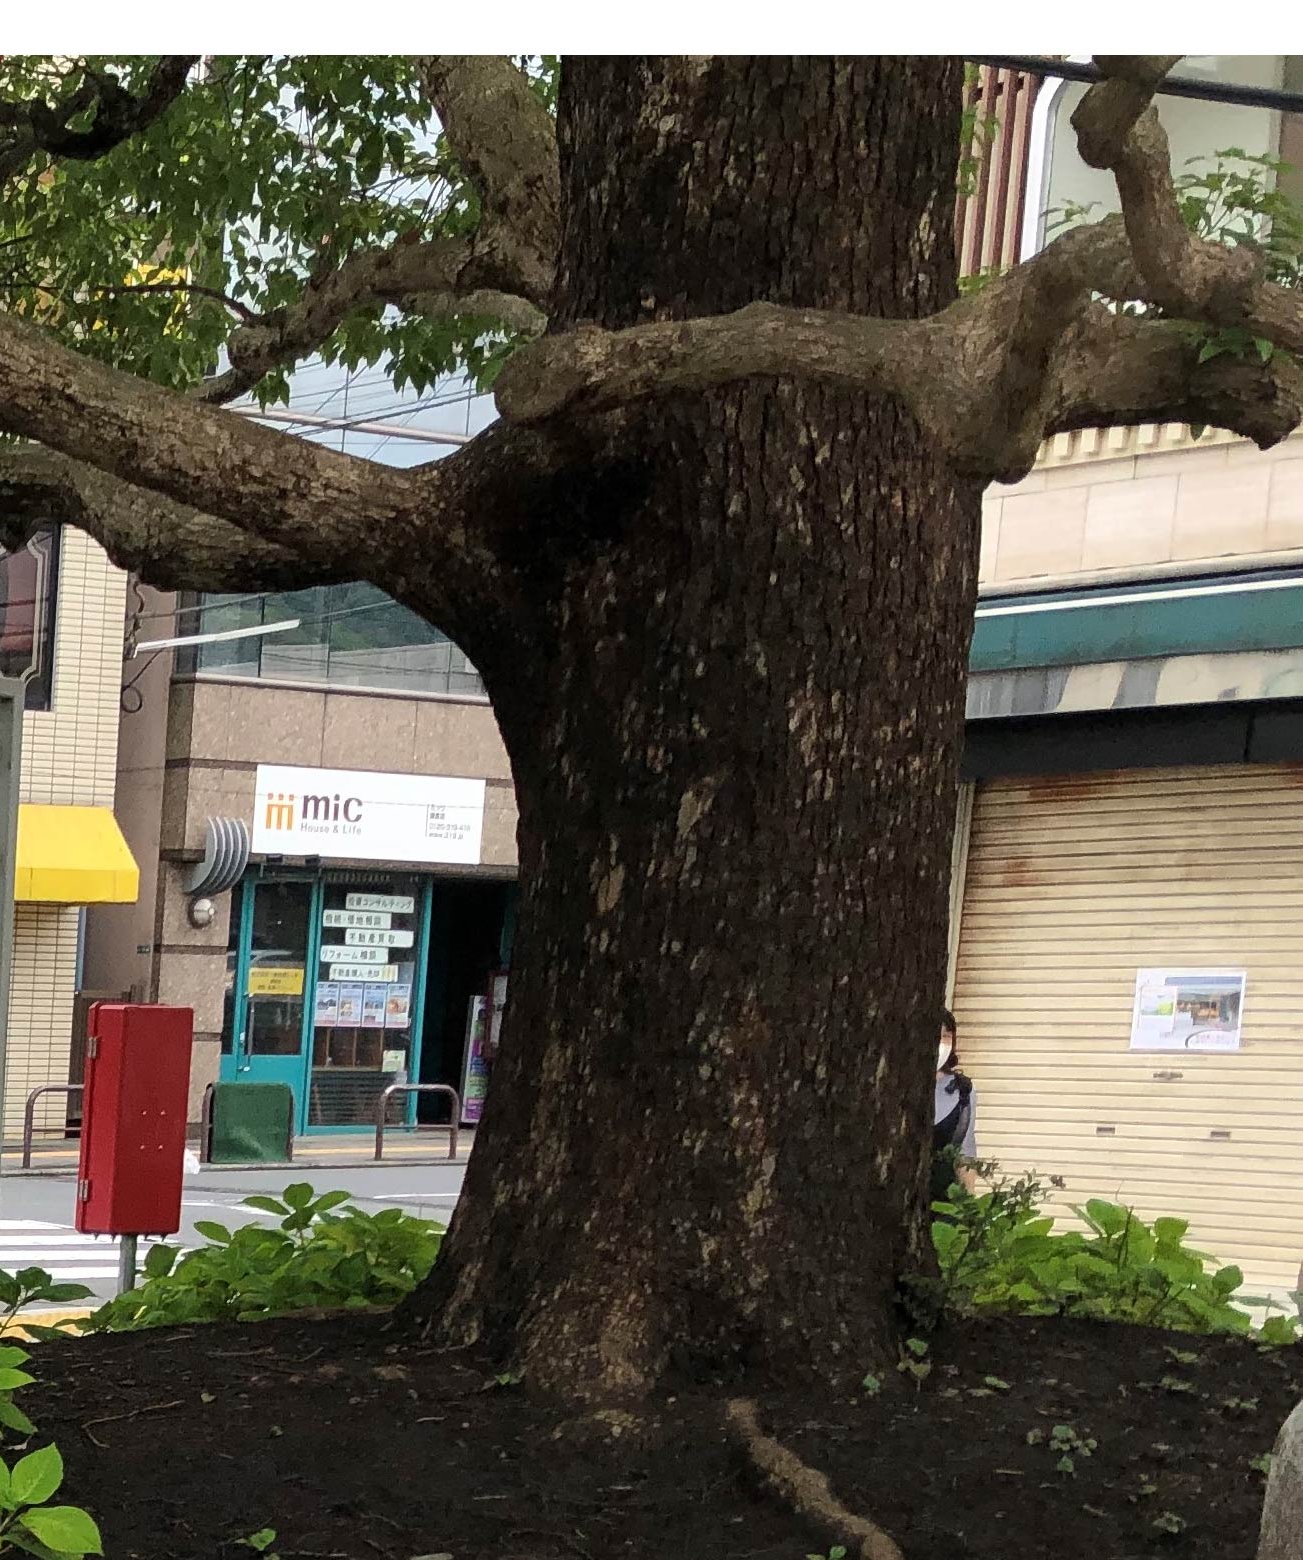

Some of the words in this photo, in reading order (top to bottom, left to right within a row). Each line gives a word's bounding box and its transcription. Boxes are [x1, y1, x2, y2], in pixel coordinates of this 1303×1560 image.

[301, 793, 363, 823] mic
[300, 822, 330, 834] House
[332, 823, 339, 834] &
[342, 824, 362, 836] Life
